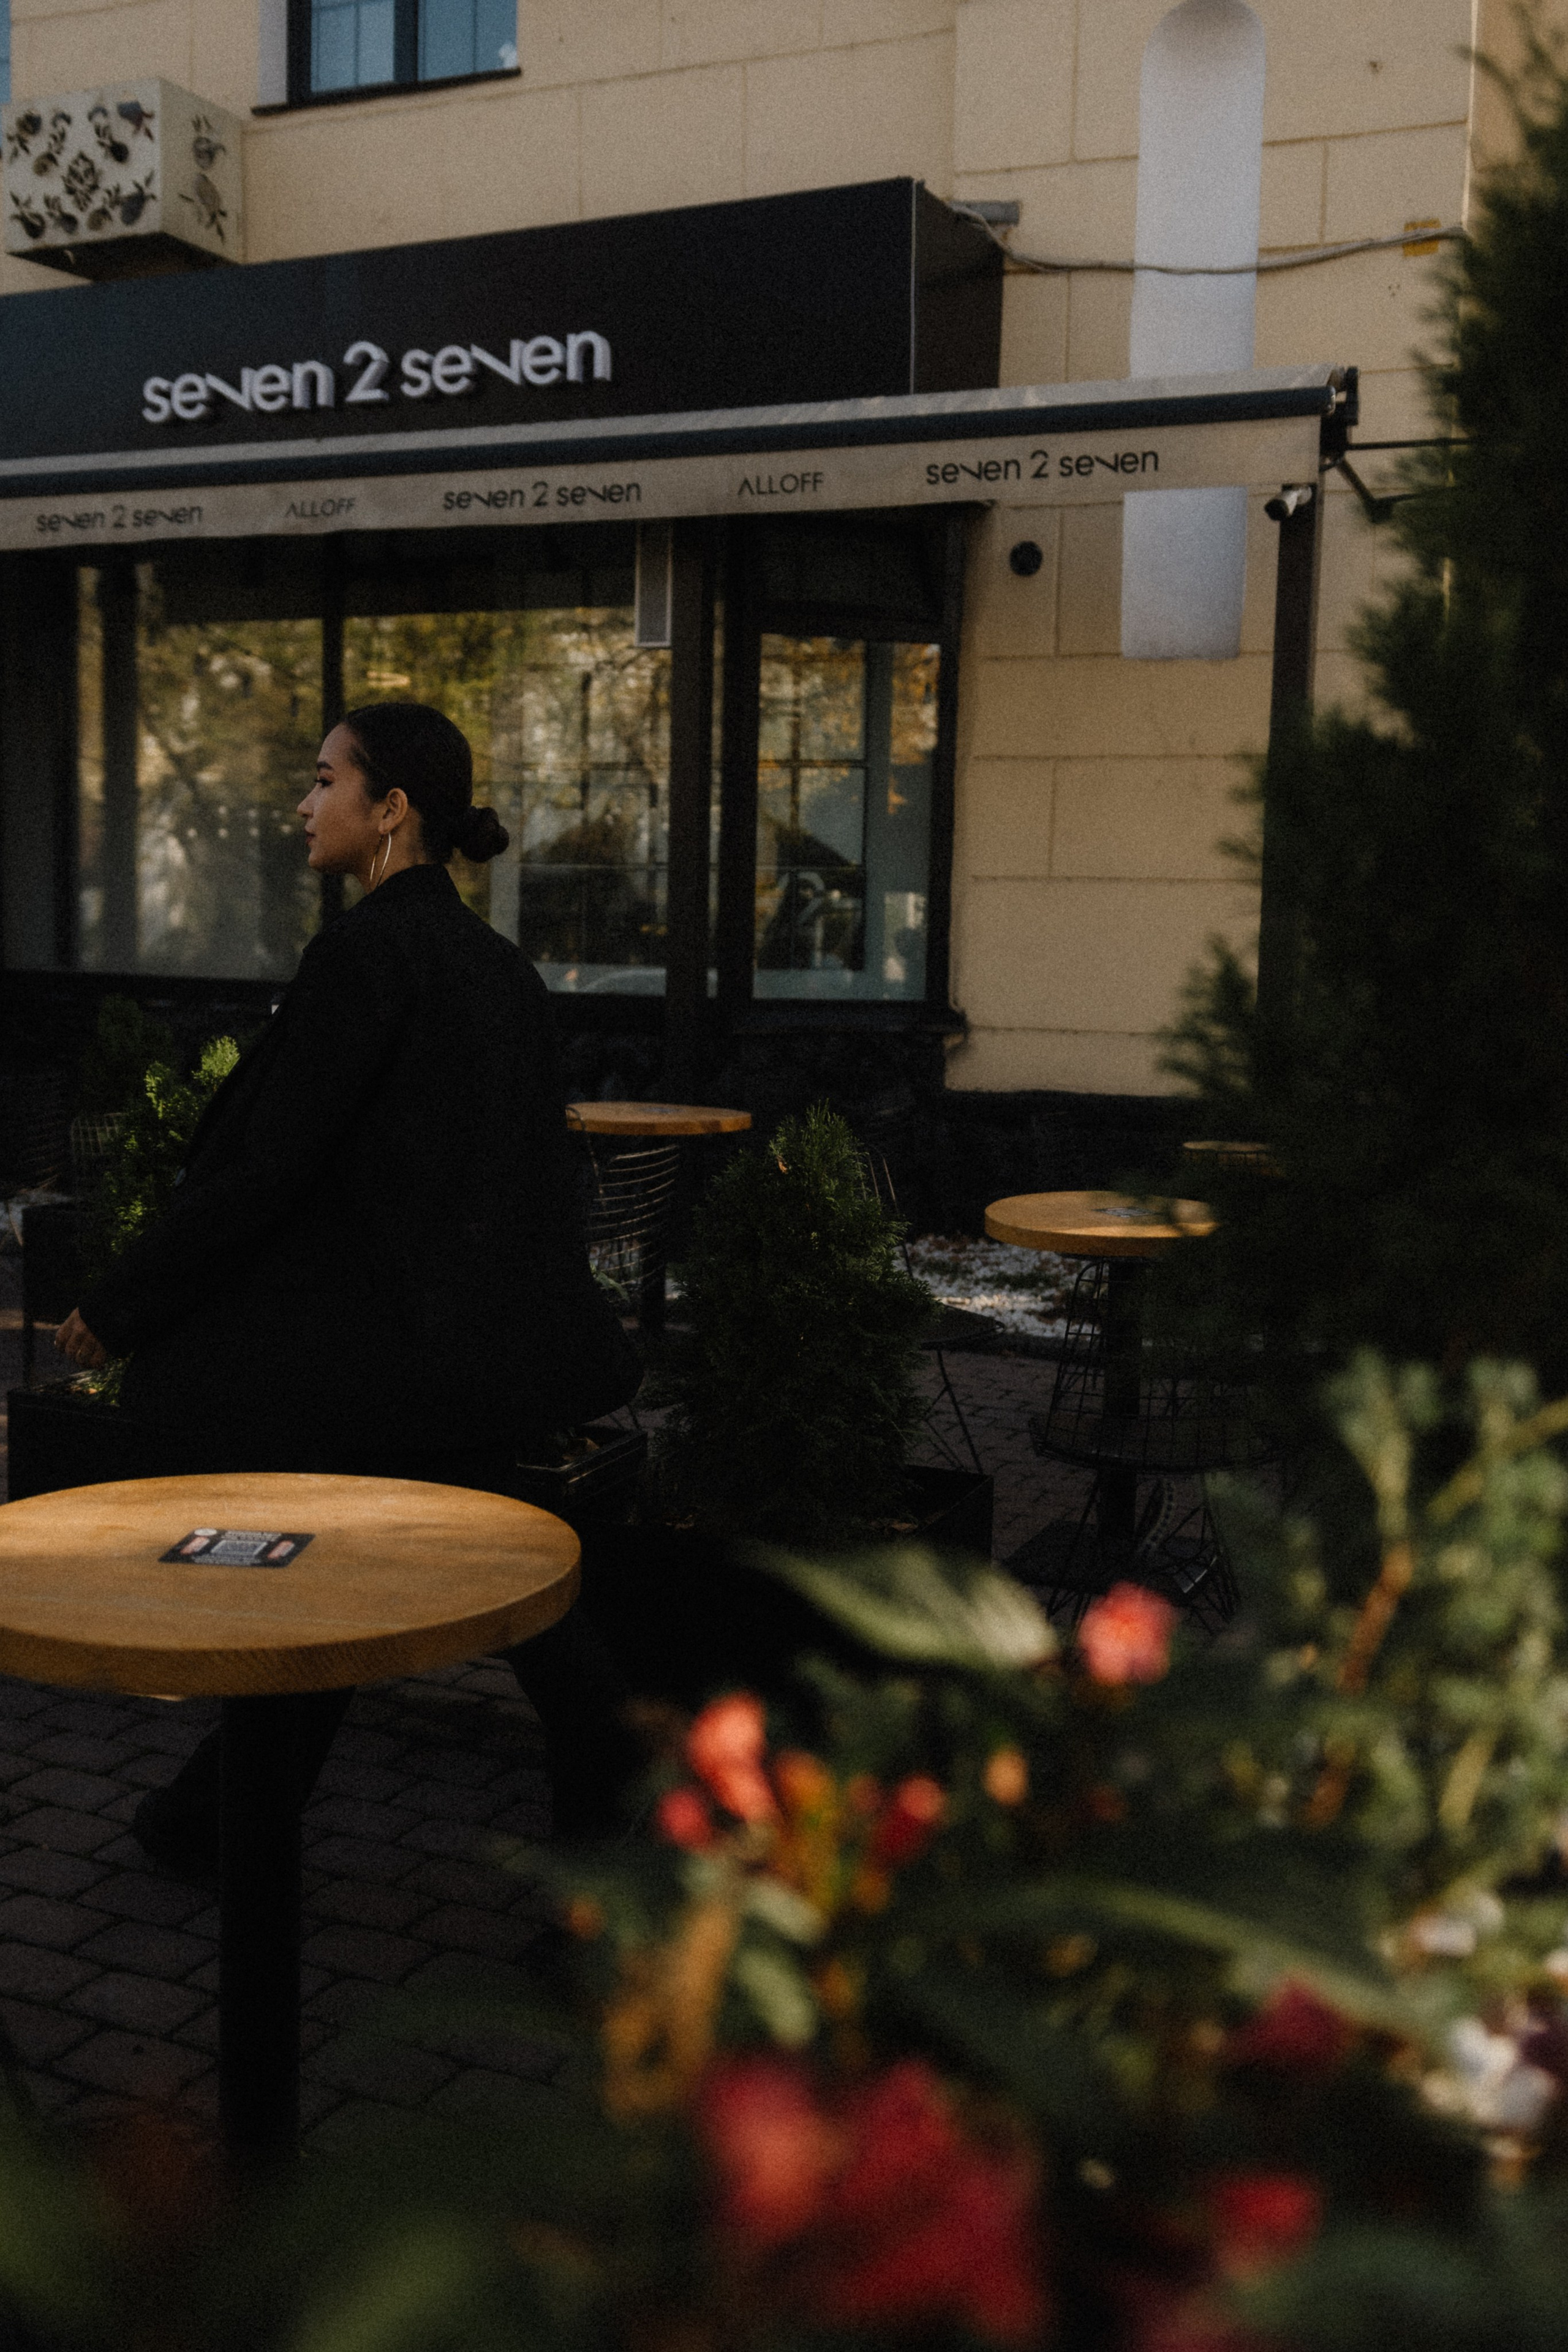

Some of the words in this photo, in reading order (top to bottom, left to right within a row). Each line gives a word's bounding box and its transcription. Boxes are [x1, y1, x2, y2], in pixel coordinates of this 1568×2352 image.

[142, 360, 336, 423] seven
[343, 341, 390, 403] 2
[400, 331, 612, 398] seven
[926, 458, 1021, 484] seven
[1030, 449, 1049, 478] 2
[1059, 450, 1159, 477] seven
[443, 489, 524, 510] seven
[532, 481, 549, 507] 2
[556, 482, 641, 506] seven
[737, 471, 824, 495] ALLOFF
[37, 511, 105, 532] seven
[112, 504, 125, 529] 2
[132, 506, 203, 527] seven
[284, 497, 356, 519] ALLOFF
